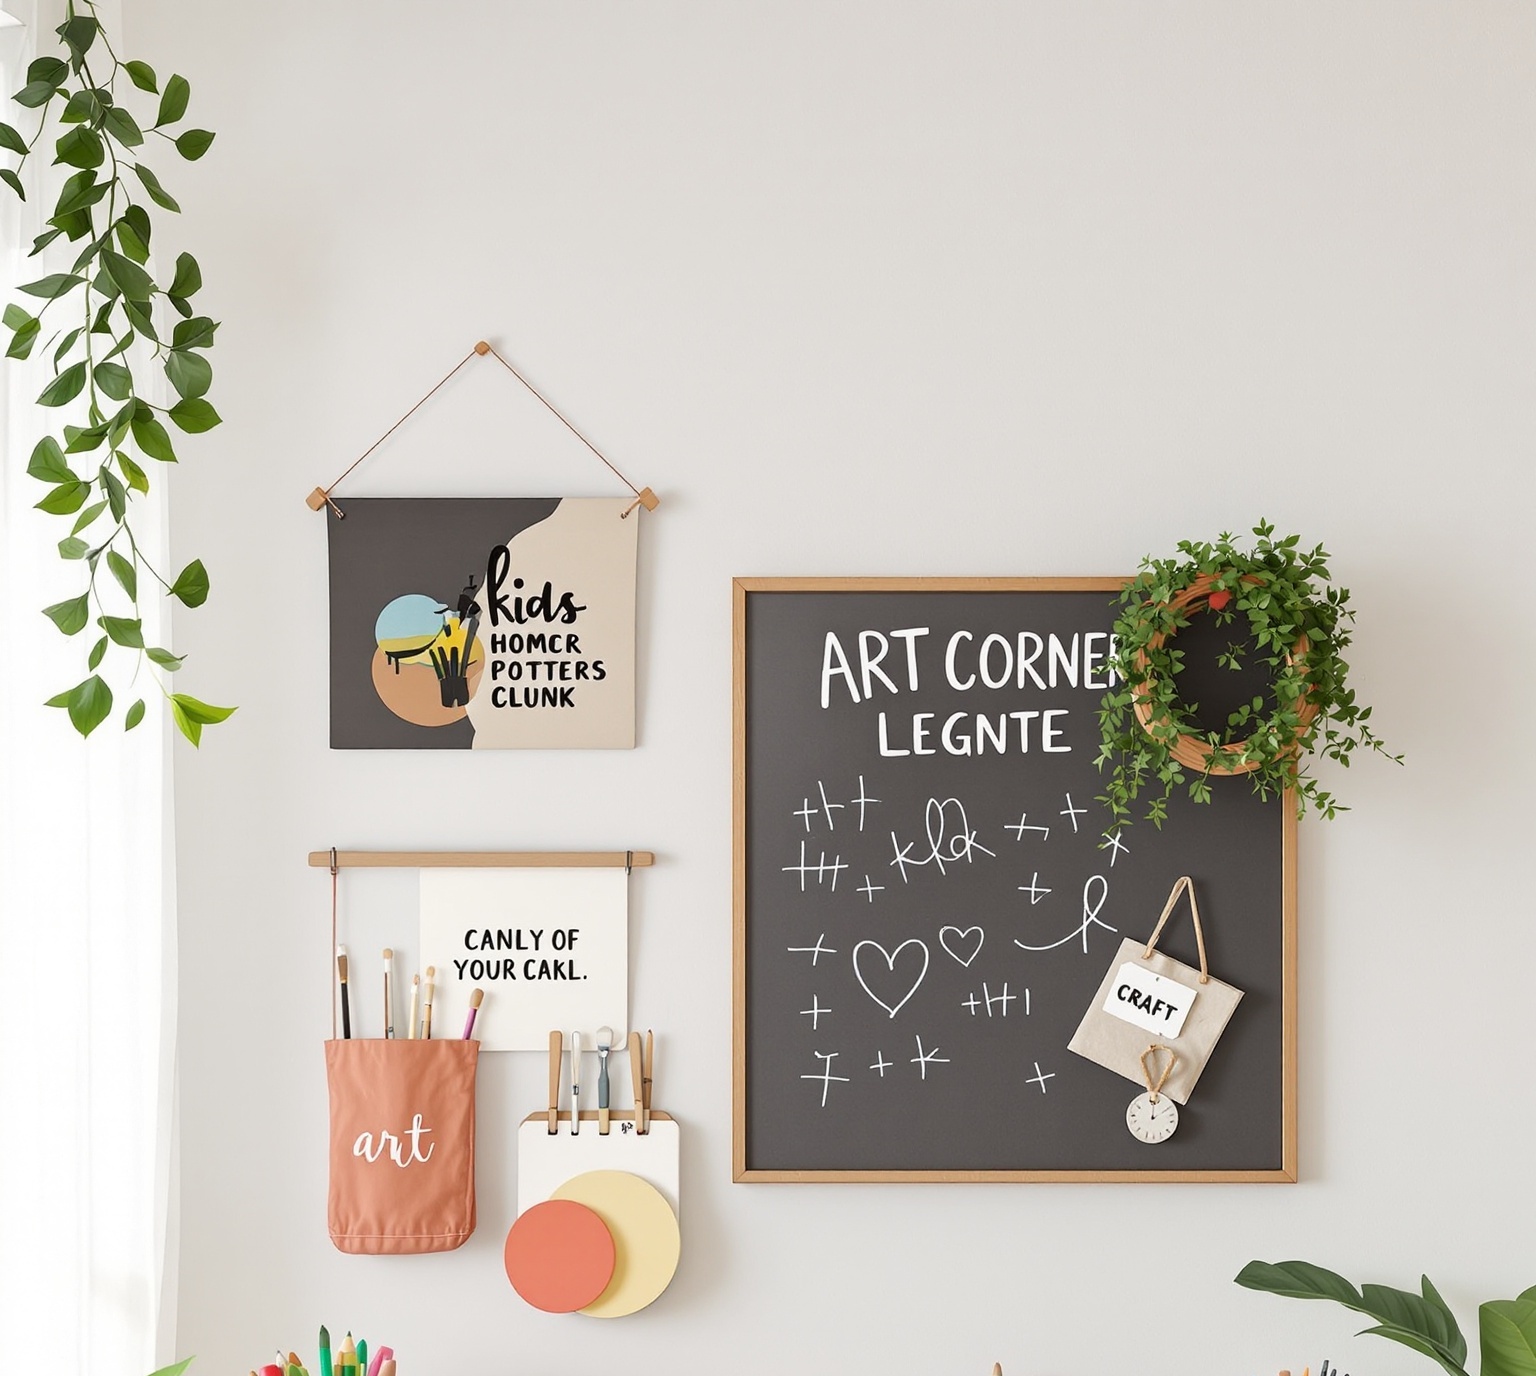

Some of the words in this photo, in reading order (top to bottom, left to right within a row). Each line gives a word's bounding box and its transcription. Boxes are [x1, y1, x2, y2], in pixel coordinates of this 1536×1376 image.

[486, 544, 587, 628] kids
[491, 659, 607, 681] POTTERS
[820, 627, 932, 709] ART
[491, 686, 575, 709] CLUNK
[878, 709, 1072, 757] LEGNTE
[464, 927, 544, 951] CANLY
[551, 927, 580, 951] OF
[453, 958, 517, 981] YOUR
[523, 958, 589, 981] CAKL.
[1116, 983, 1179, 1023] CRAFT
[352, 1113, 435, 1168] art
